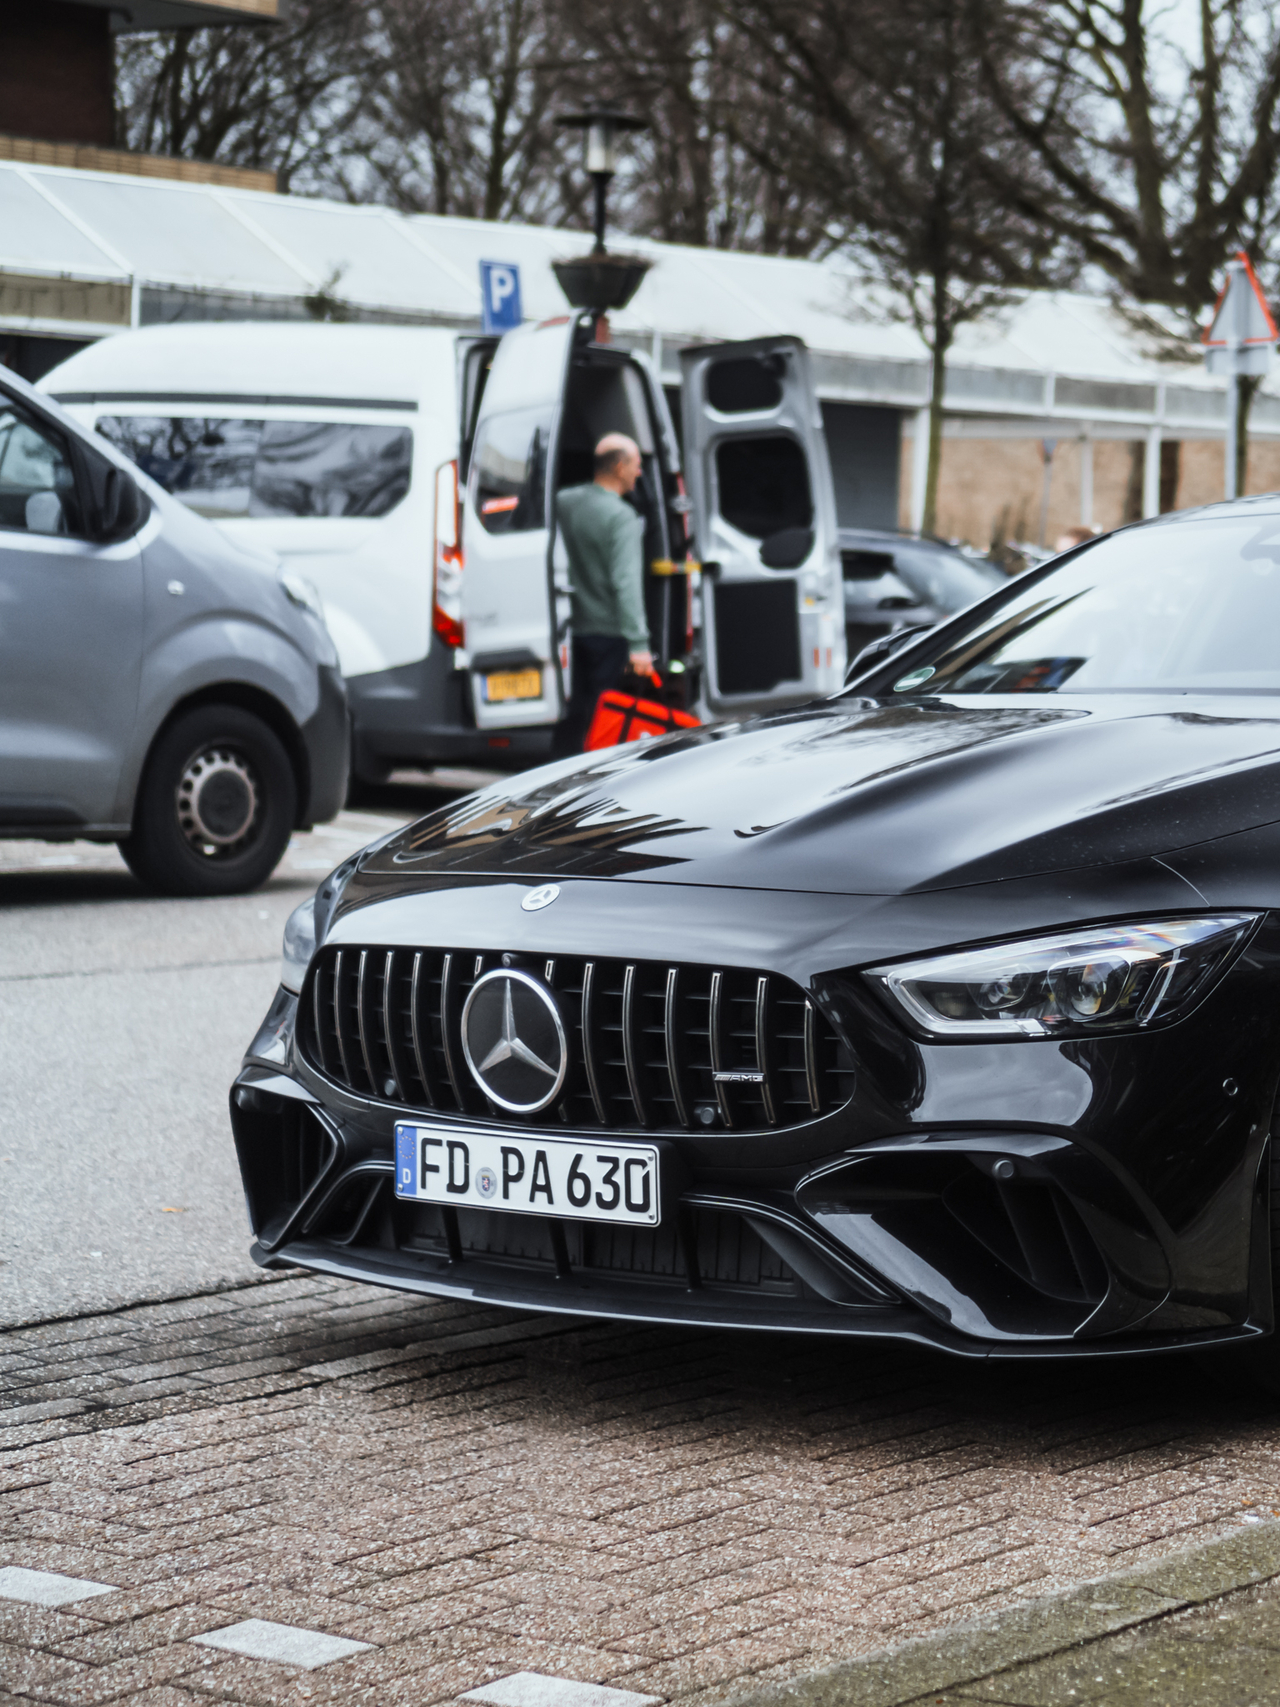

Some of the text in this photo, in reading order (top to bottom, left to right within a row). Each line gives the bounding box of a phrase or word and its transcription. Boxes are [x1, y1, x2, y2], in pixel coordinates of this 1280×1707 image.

[490, 268, 515, 313] P
[728, 1074, 763, 1082] AMG
[402, 1167, 412, 1184] D
[421, 1137, 470, 1195] FD
[500, 1146, 555, 1205] PA
[567, 1153, 651, 1213] 630
